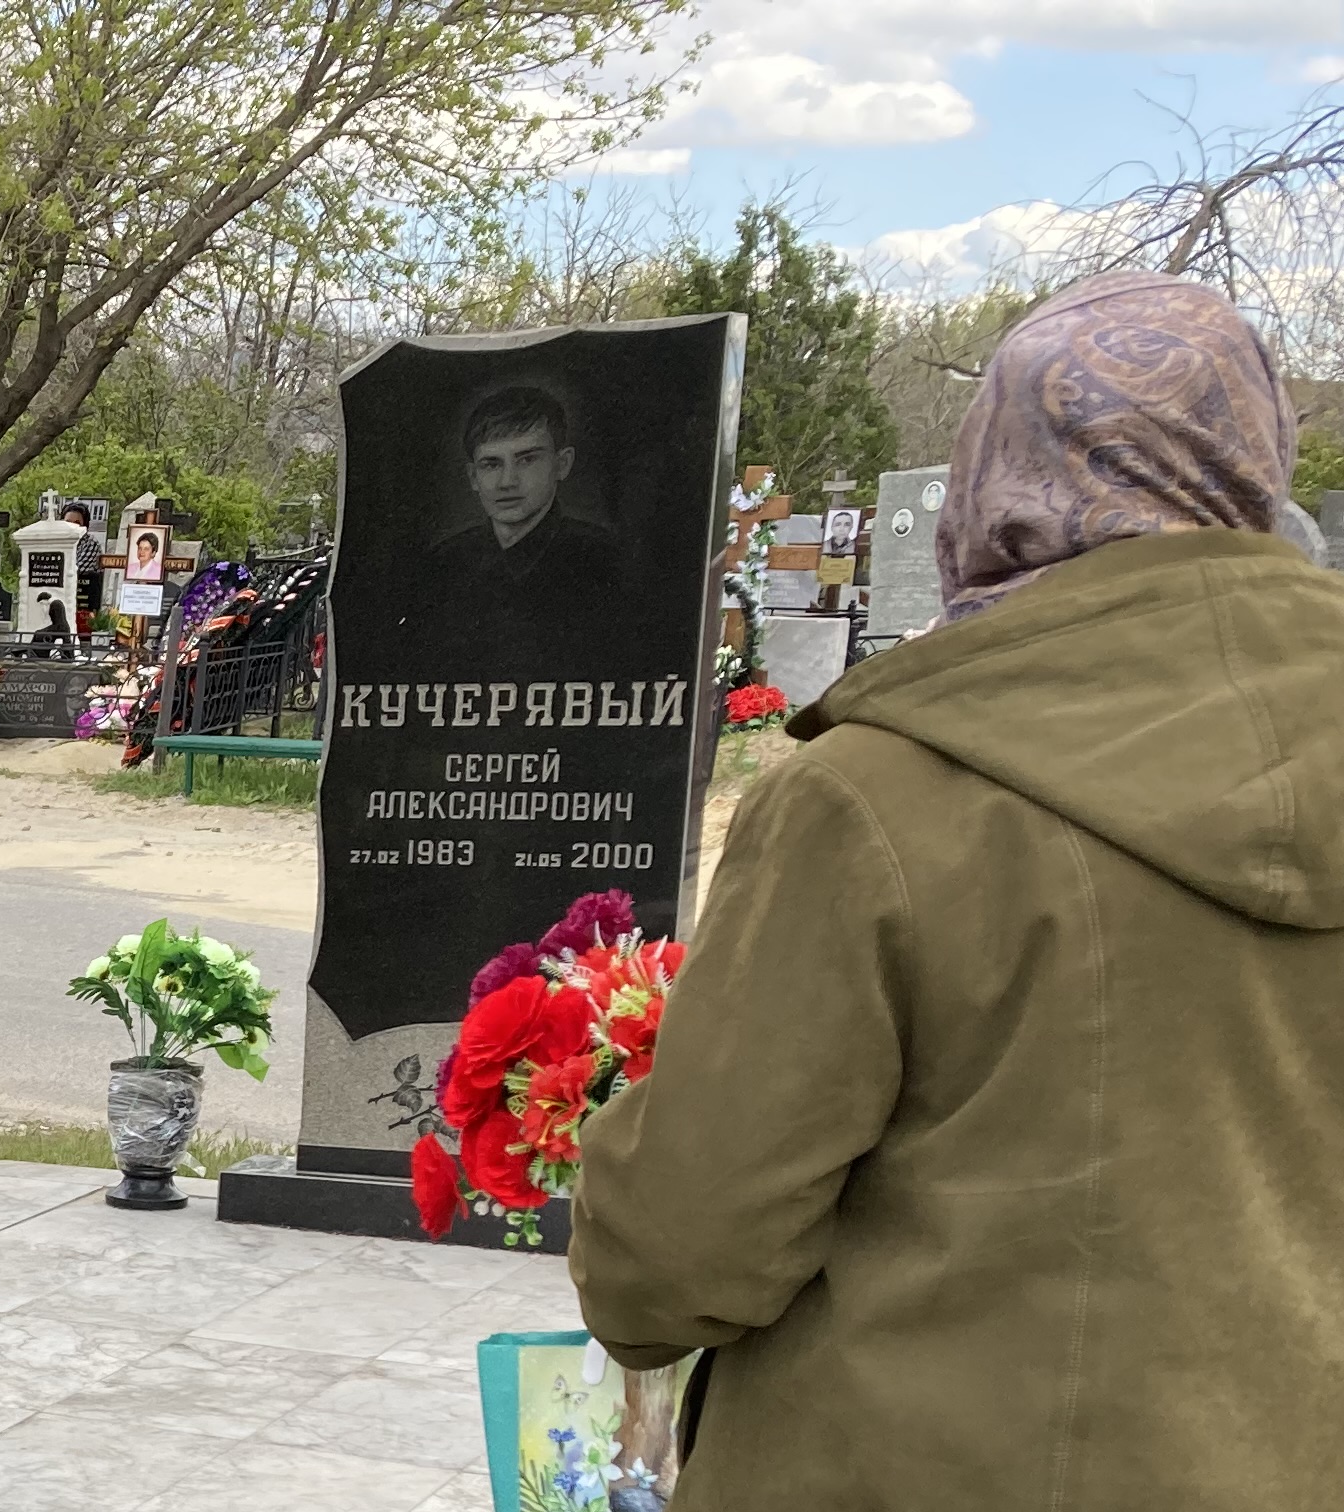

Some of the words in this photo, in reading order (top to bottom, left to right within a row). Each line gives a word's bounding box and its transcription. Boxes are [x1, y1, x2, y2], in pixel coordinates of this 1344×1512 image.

[340, 673, 688, 727] КУЧЕРЯВЫЙ
[444, 748, 561, 783] СЕРГЕЙ
[367, 791, 634, 821] АЛЕКСАНДРОВИЧ
[349, 849, 400, 865] 27.02
[407, 839, 476, 867] 1983
[514, 852, 562, 868] 21.05
[570, 842, 655, 869] 2000
